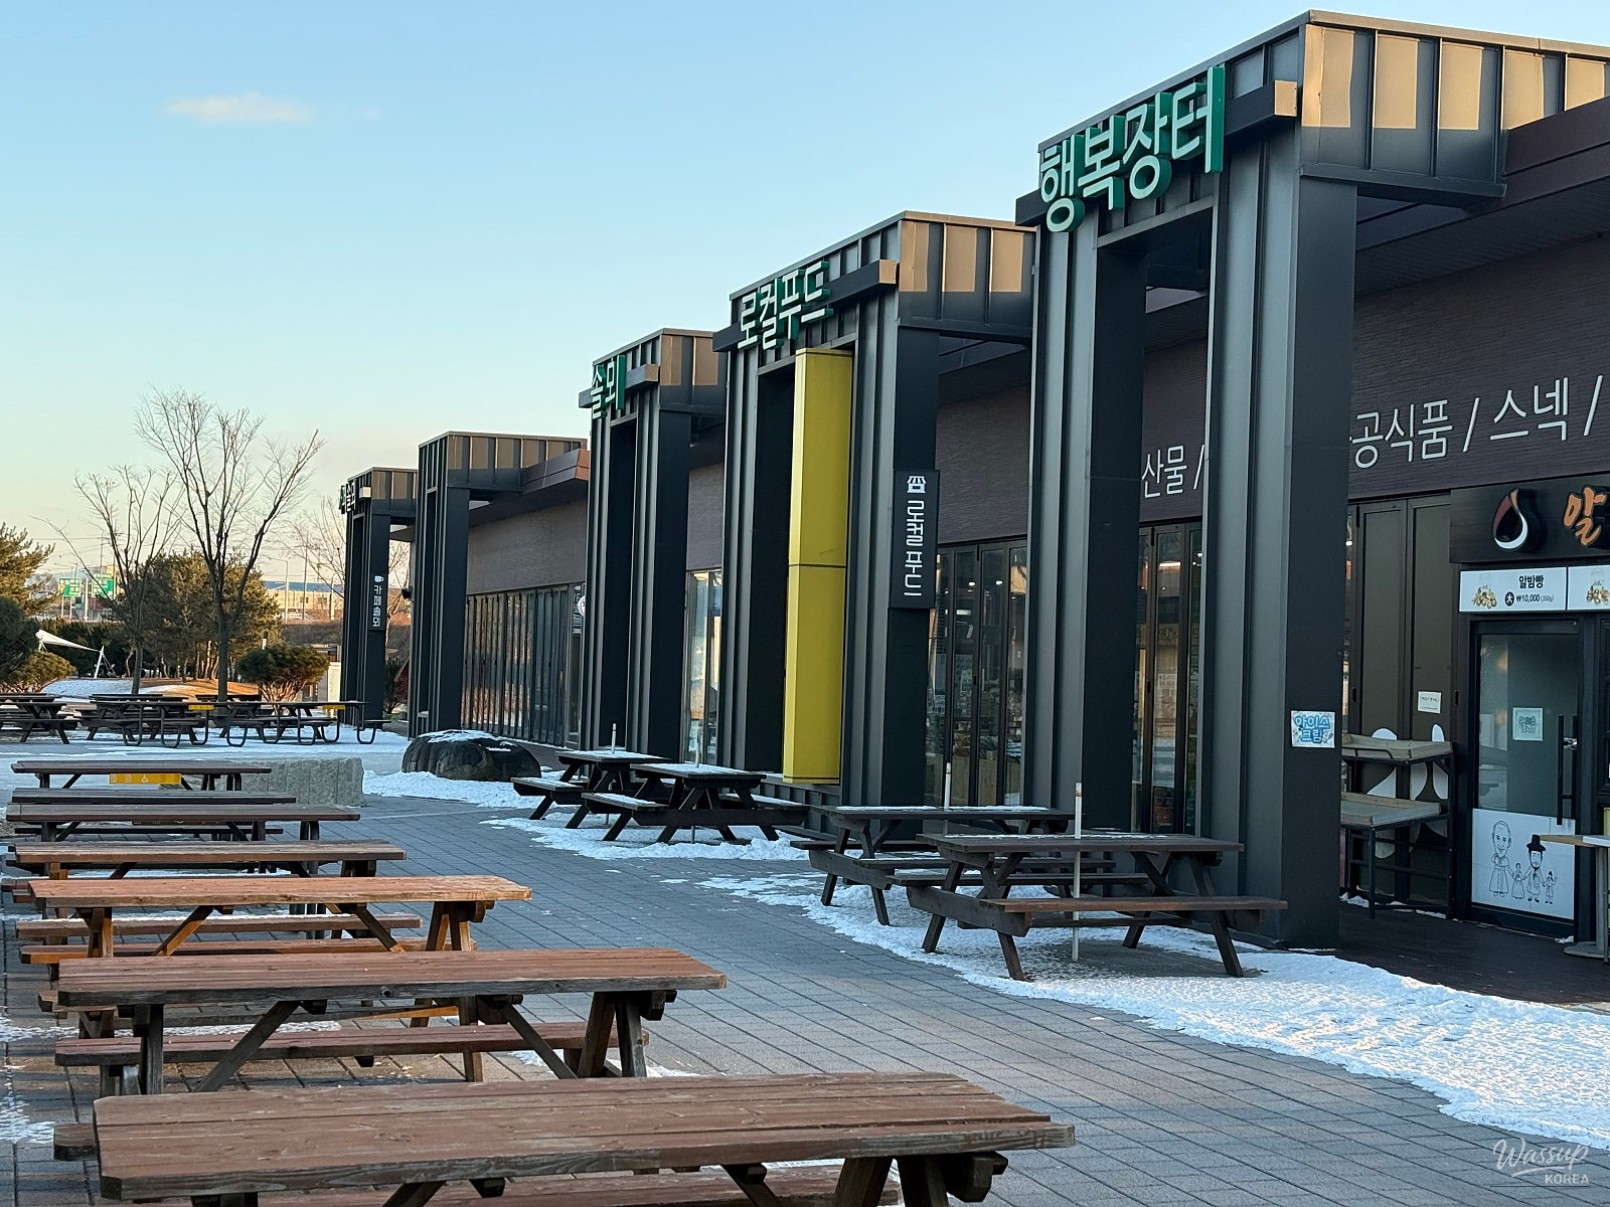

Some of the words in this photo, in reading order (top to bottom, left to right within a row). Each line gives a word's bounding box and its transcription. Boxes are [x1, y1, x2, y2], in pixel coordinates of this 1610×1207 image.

[1040, 66, 1224, 232] 행복장터
[738, 261, 832, 350] 로컬푸드
[591, 355, 626, 419] 솔뫼
[1350, 399, 1453, 469] 공식품
[1490, 377, 1569, 441] 스넥
[904, 500, 925, 596] 로컬푸드
[1518, 574, 1544, 589] 알밤빵
[1295, 714, 1330, 728] 아이스
[1301, 728, 1322, 743] 크림
